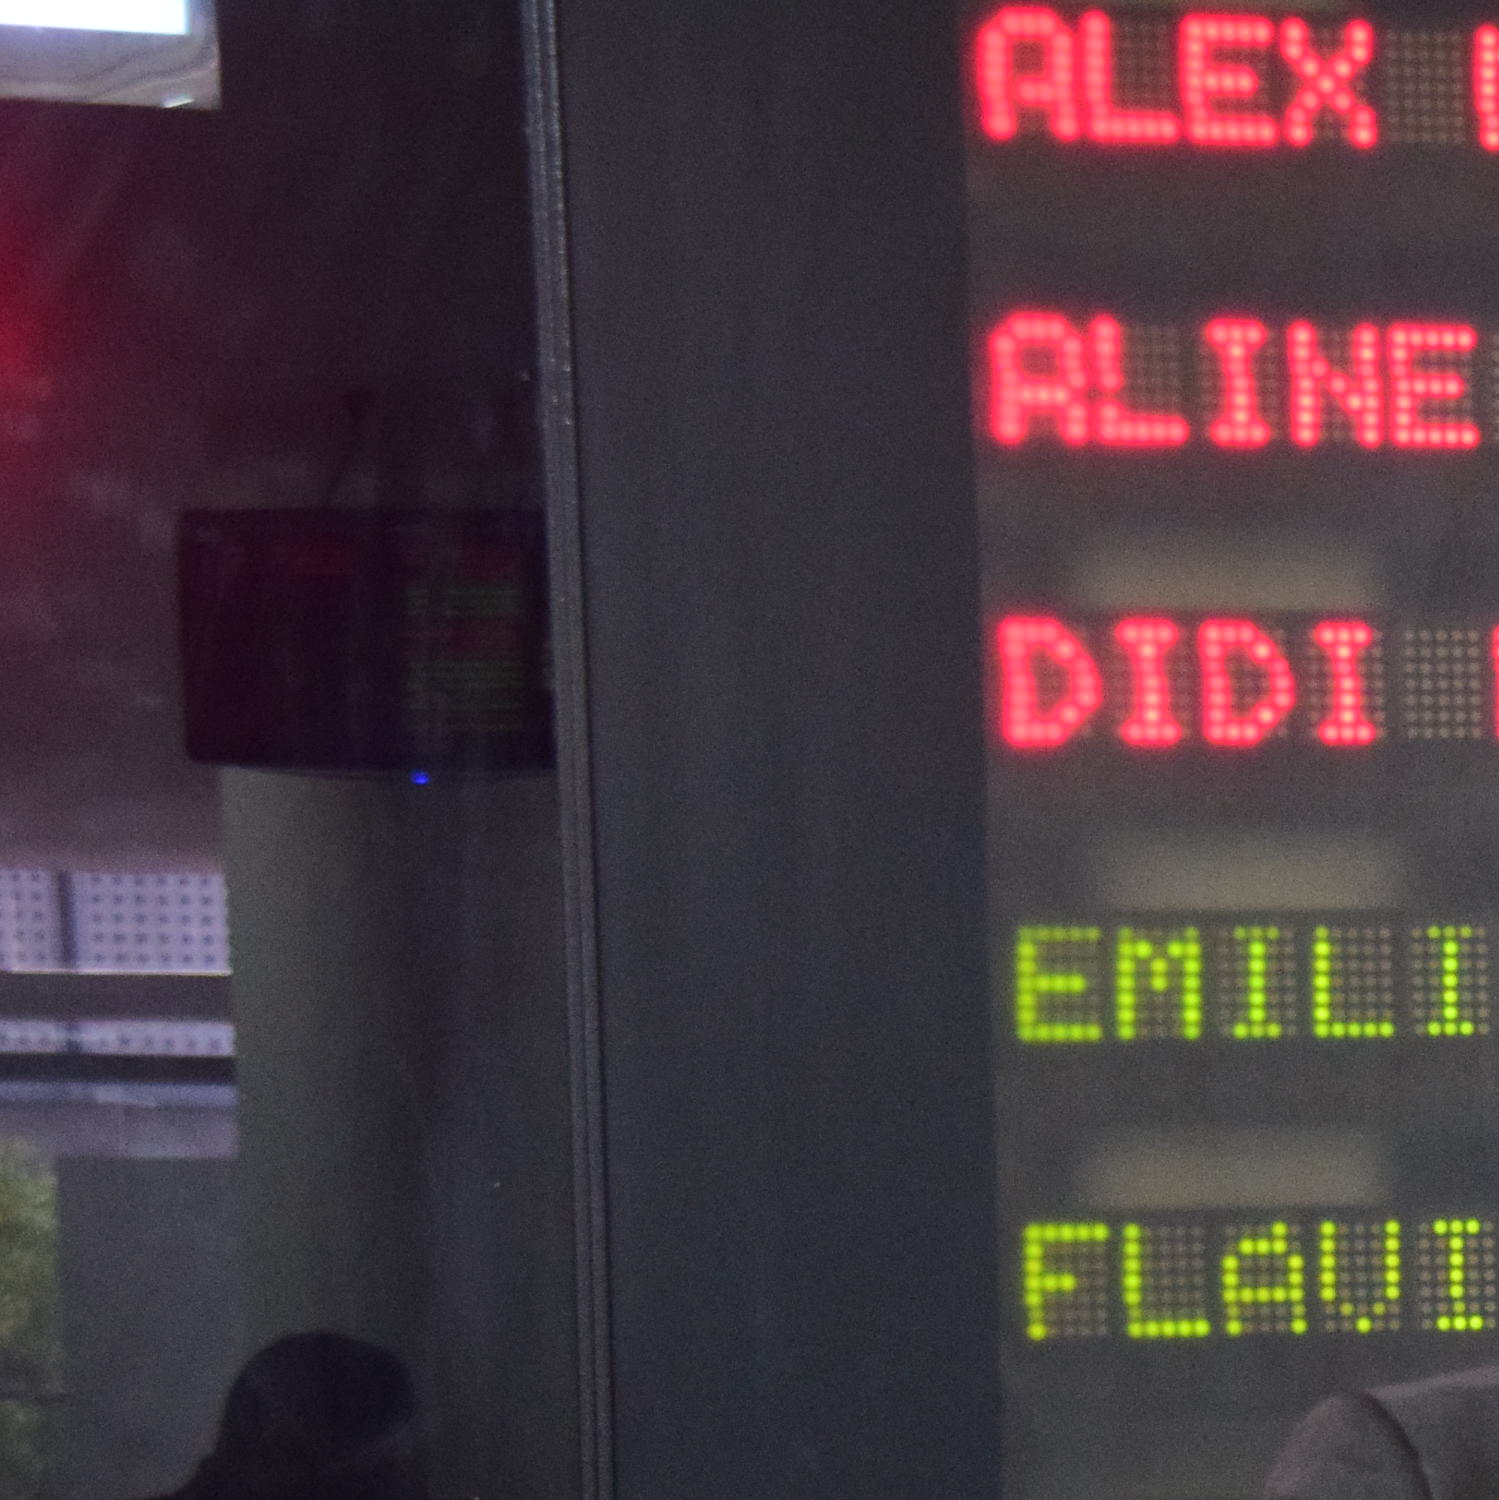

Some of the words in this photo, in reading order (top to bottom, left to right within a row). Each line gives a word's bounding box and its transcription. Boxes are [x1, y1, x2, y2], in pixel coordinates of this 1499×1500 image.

[976, 7, 1378, 148] ALEX
[988, 311, 1480, 449] ALINE
[997, 616, 1376, 748] DIDI
